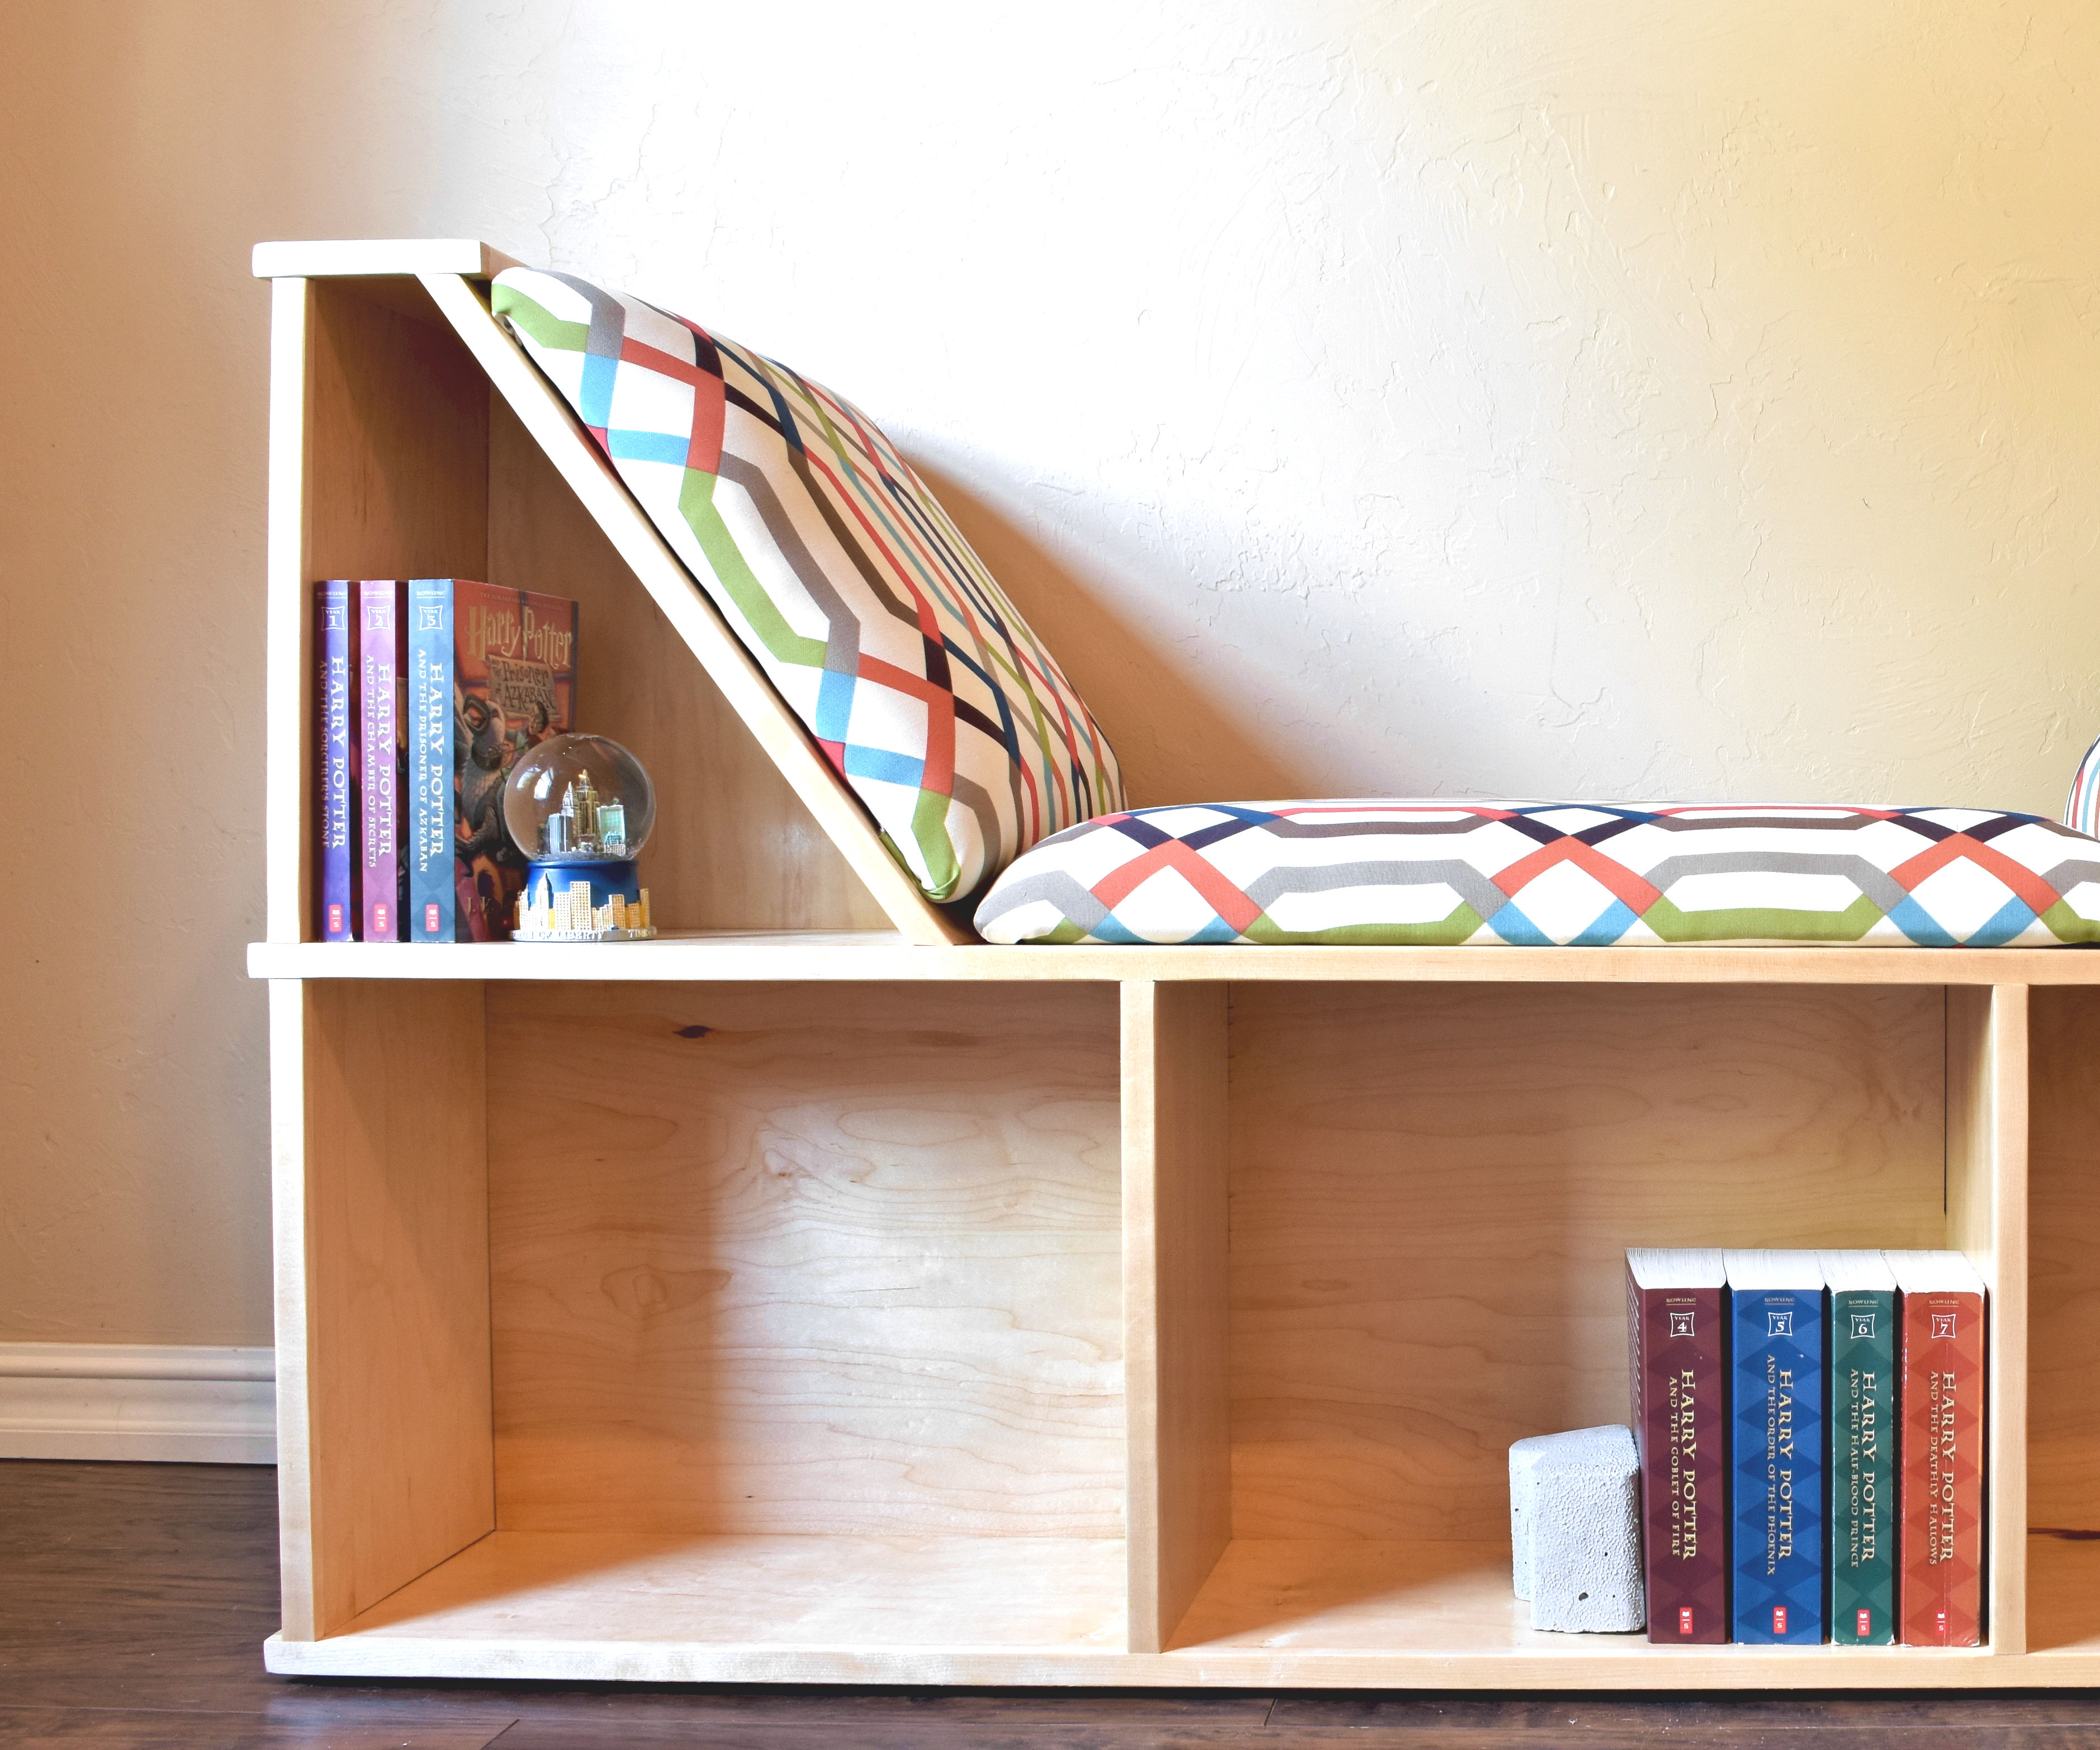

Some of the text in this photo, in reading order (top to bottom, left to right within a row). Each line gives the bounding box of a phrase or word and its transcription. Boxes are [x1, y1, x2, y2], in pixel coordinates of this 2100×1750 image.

[329, 615, 338, 627] 1
[375, 614, 383, 627] 2
[464, 605, 573, 670] Harry Potter
[319, 660, 328, 690] AND
[320, 694, 329, 723] THE
[331, 656, 346, 848] HARRY POTTER
[366, 655, 376, 867] AND THE CHAMBER OF SECRETS
[377, 663, 392, 857] HARRY POTTER
[418, 649, 428, 872] AND THE PRISONER OF AZKABAN
[429, 663, 444, 857] HARRY POTTER
[1677, 1321, 1687, 1332] 4
[1775, 1321, 1785, 1334] 5
[1859, 1324, 1867, 1334] 6
[1940, 1324, 1949, 1335] 7
[1767, 1354, 1775, 1384] AND
[1850, 1368, 1859, 1398] AND
[1669, 1376, 1677, 1408] AND
[1681, 1369, 1697, 1561] HARRY POTTER
[1768, 1464, 1775, 1481] OF
[1778, 1369, 1794, 1560] HARRY POTTER
[1850, 1435, 1859, 1516] HALF-BLOOD
[1861, 1370, 1876, 1562] HARRY POTTER
[1929, 1370, 1939, 1564] AND THE DEATHLY HALLOWS
[1940, 1370, 1956, 1562] HARRY POTTER
[1672, 1501, 1679, 1519] OF
[1672, 1524, 1680, 1556] FIRE
